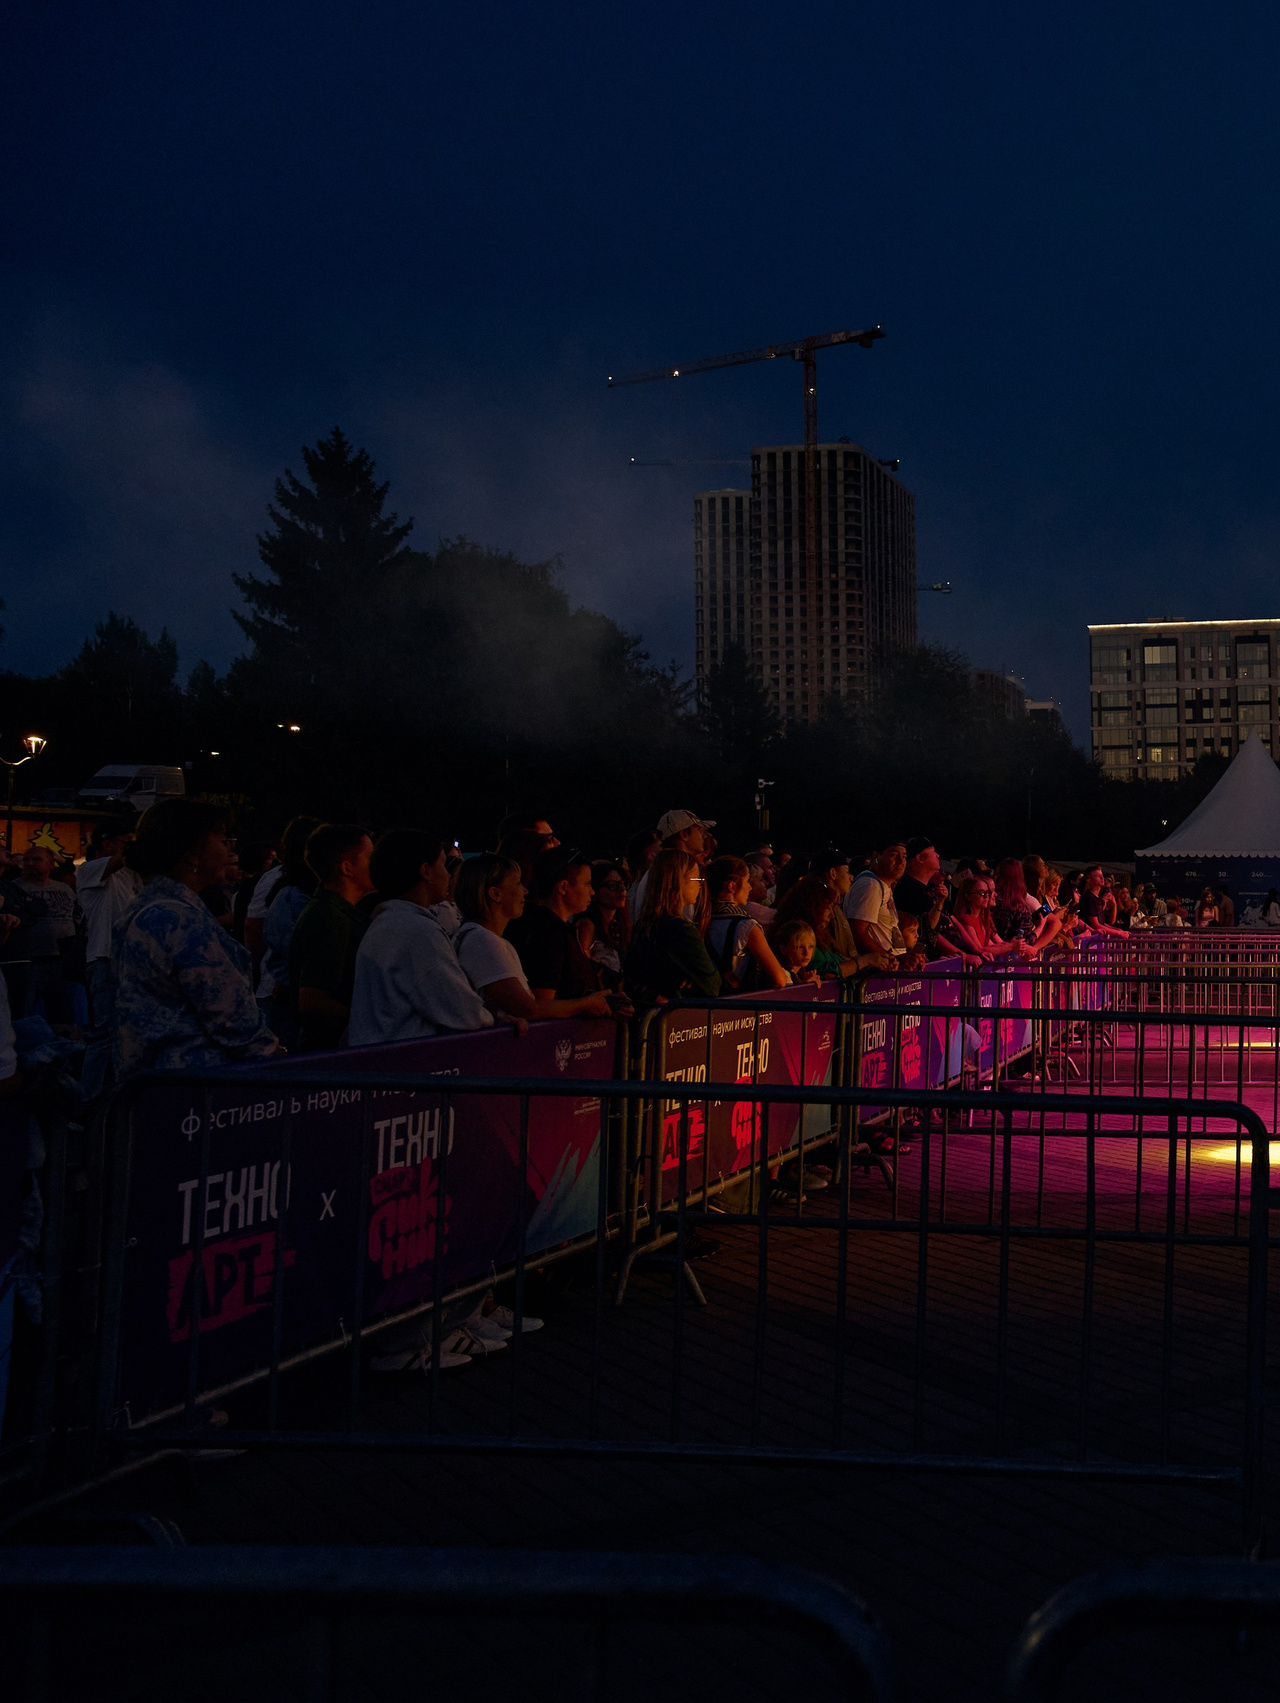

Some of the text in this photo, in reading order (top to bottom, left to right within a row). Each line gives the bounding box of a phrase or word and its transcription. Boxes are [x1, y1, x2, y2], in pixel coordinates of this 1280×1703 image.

[668, 1012, 773, 1049] фестивал науки и искуства
[862, 1018, 887, 1053] ТЕХНО
[180, 1088, 363, 1142] фестиваль науки
[373, 1105, 456, 1175] ТЕХНО
[177, 1159, 293, 1246] ТЕХНО
[176, 1244, 264, 1329] АРТ
